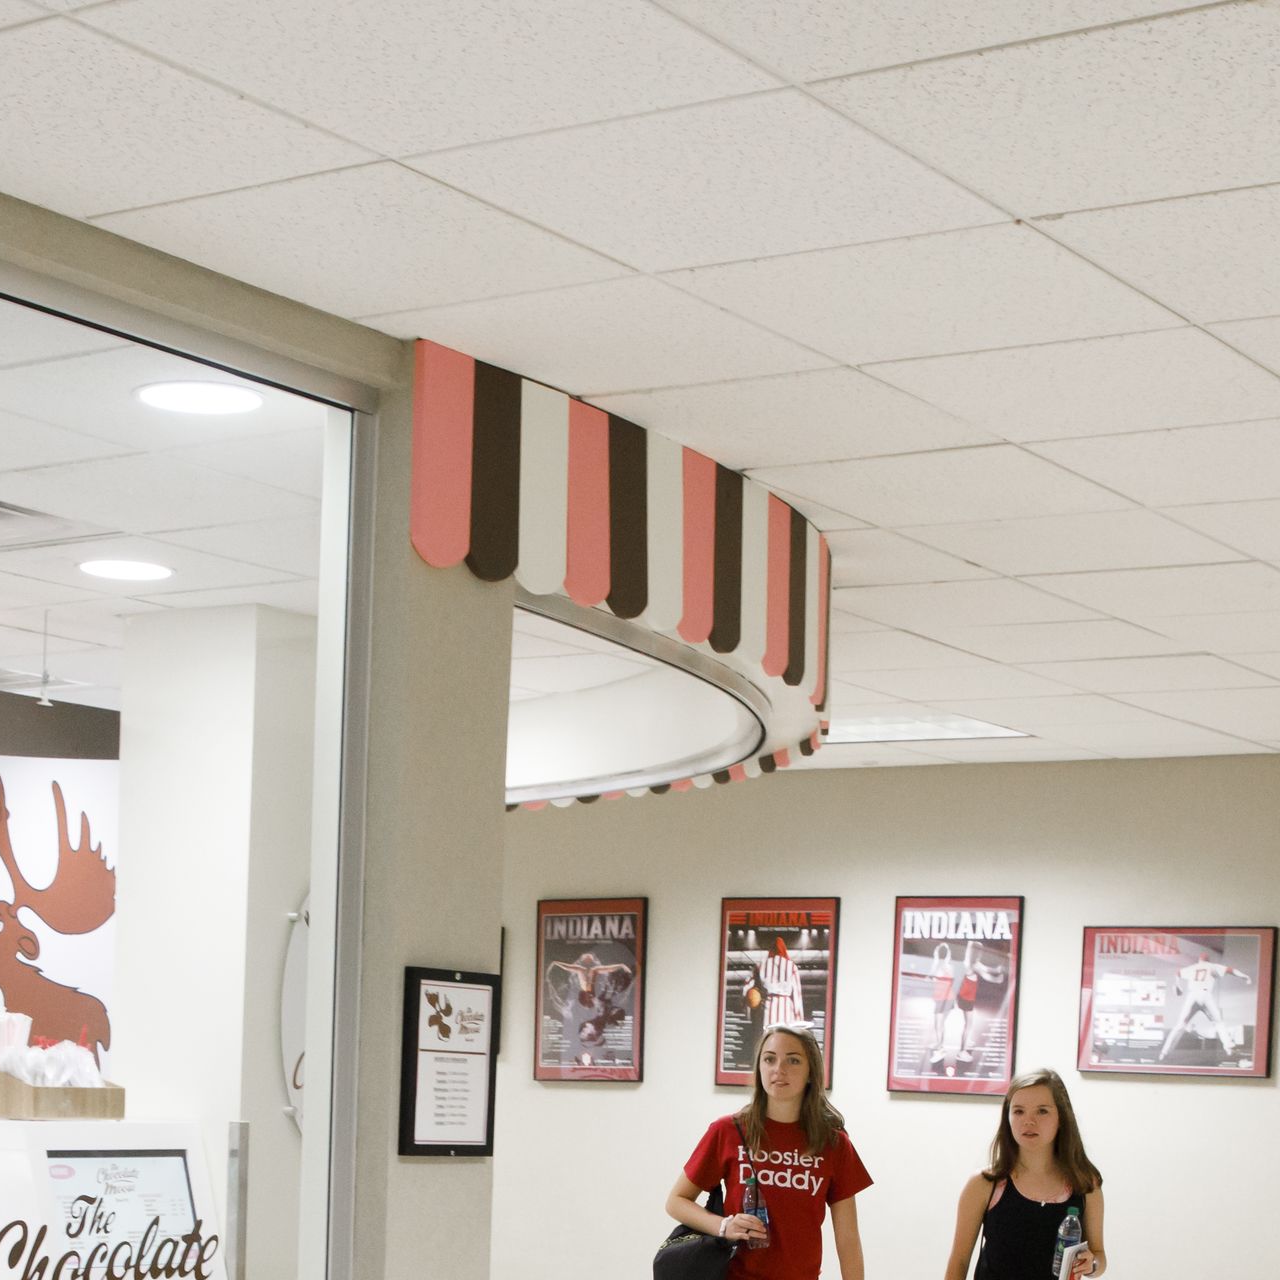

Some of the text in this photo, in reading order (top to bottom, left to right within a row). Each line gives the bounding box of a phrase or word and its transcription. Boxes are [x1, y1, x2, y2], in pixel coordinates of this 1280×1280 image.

[545, 915, 636, 940] INDIANA
[748, 912, 811, 926] INDIANA
[903, 911, 1013, 940] INDIANA
[1098, 935, 1181, 955] INDIANA
[1194, 968, 1208, 982] 17
[739, 1163, 825, 1196] Daddy
[66, 1195, 117, 1239] The
